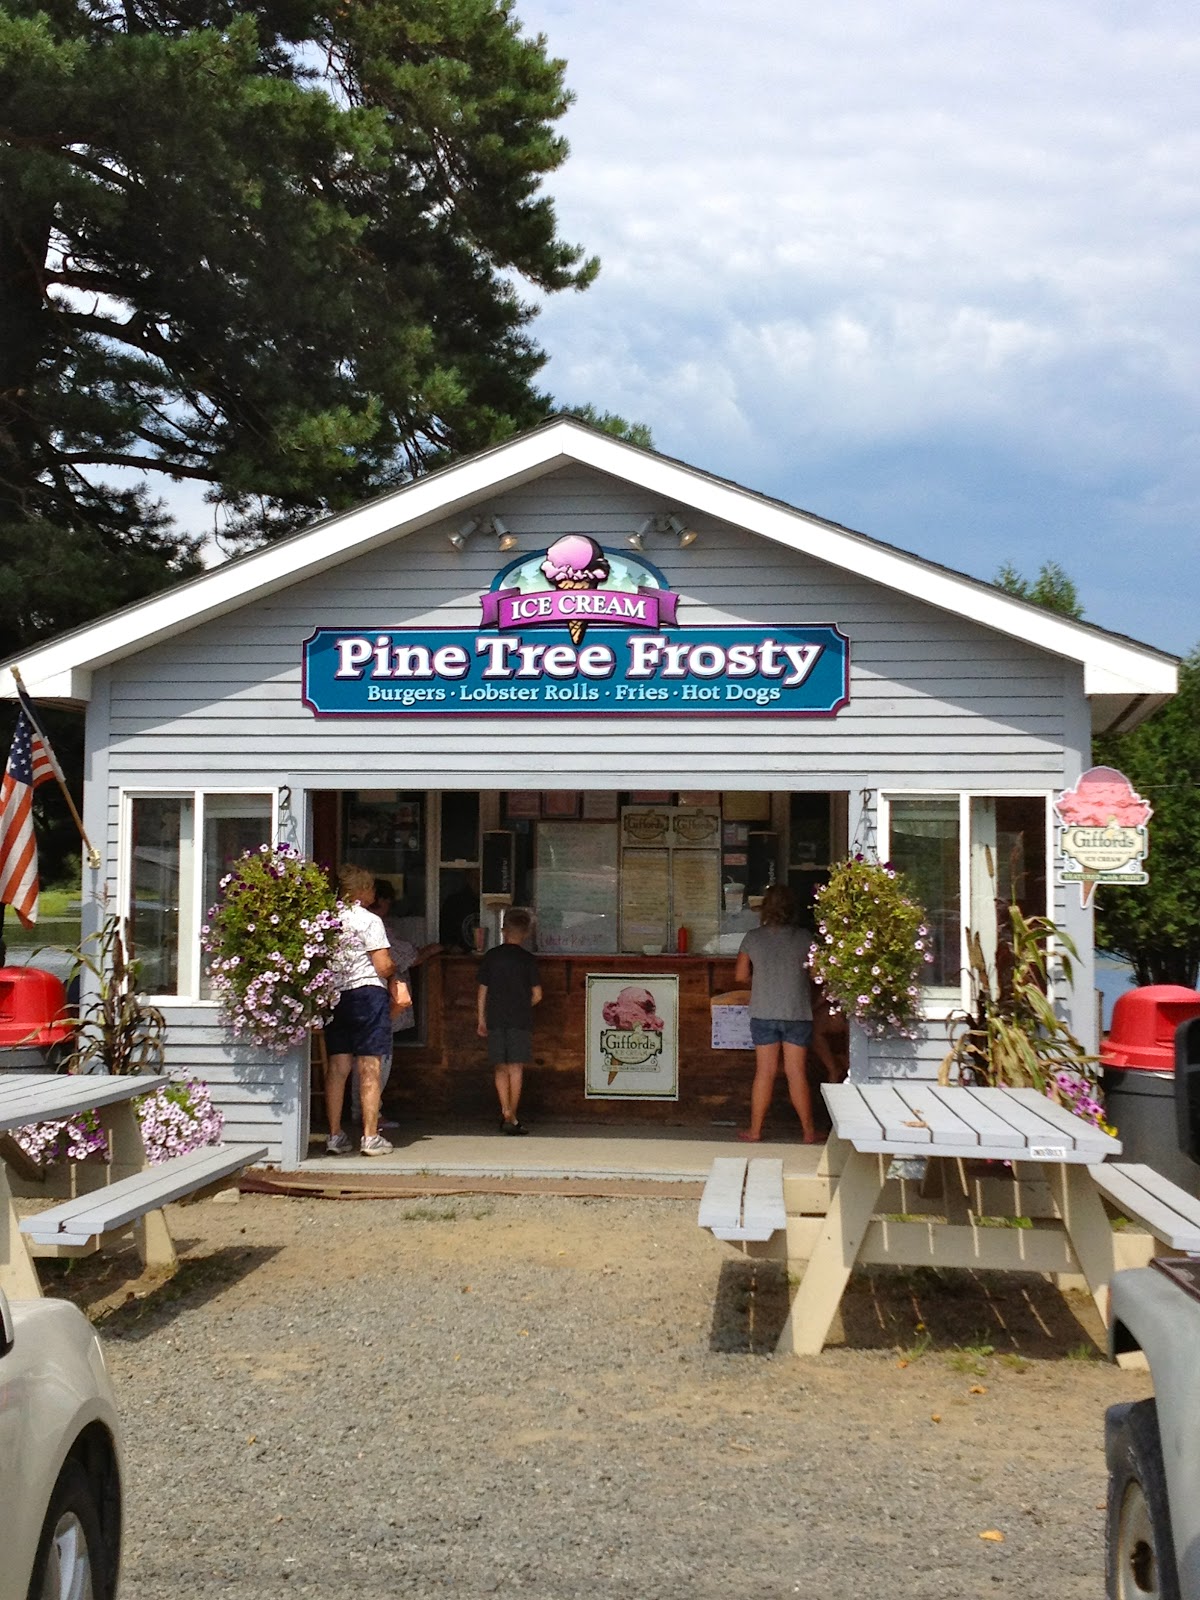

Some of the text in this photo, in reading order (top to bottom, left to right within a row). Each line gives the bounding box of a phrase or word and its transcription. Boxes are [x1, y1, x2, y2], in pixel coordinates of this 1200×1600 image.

[511, 594, 647, 620] ICE CREAM
[335, 636, 822, 687] Pine Tree Frosty
[367, 684, 781, 706] Burgers Lobster Rolls Fries Hot Dogs
